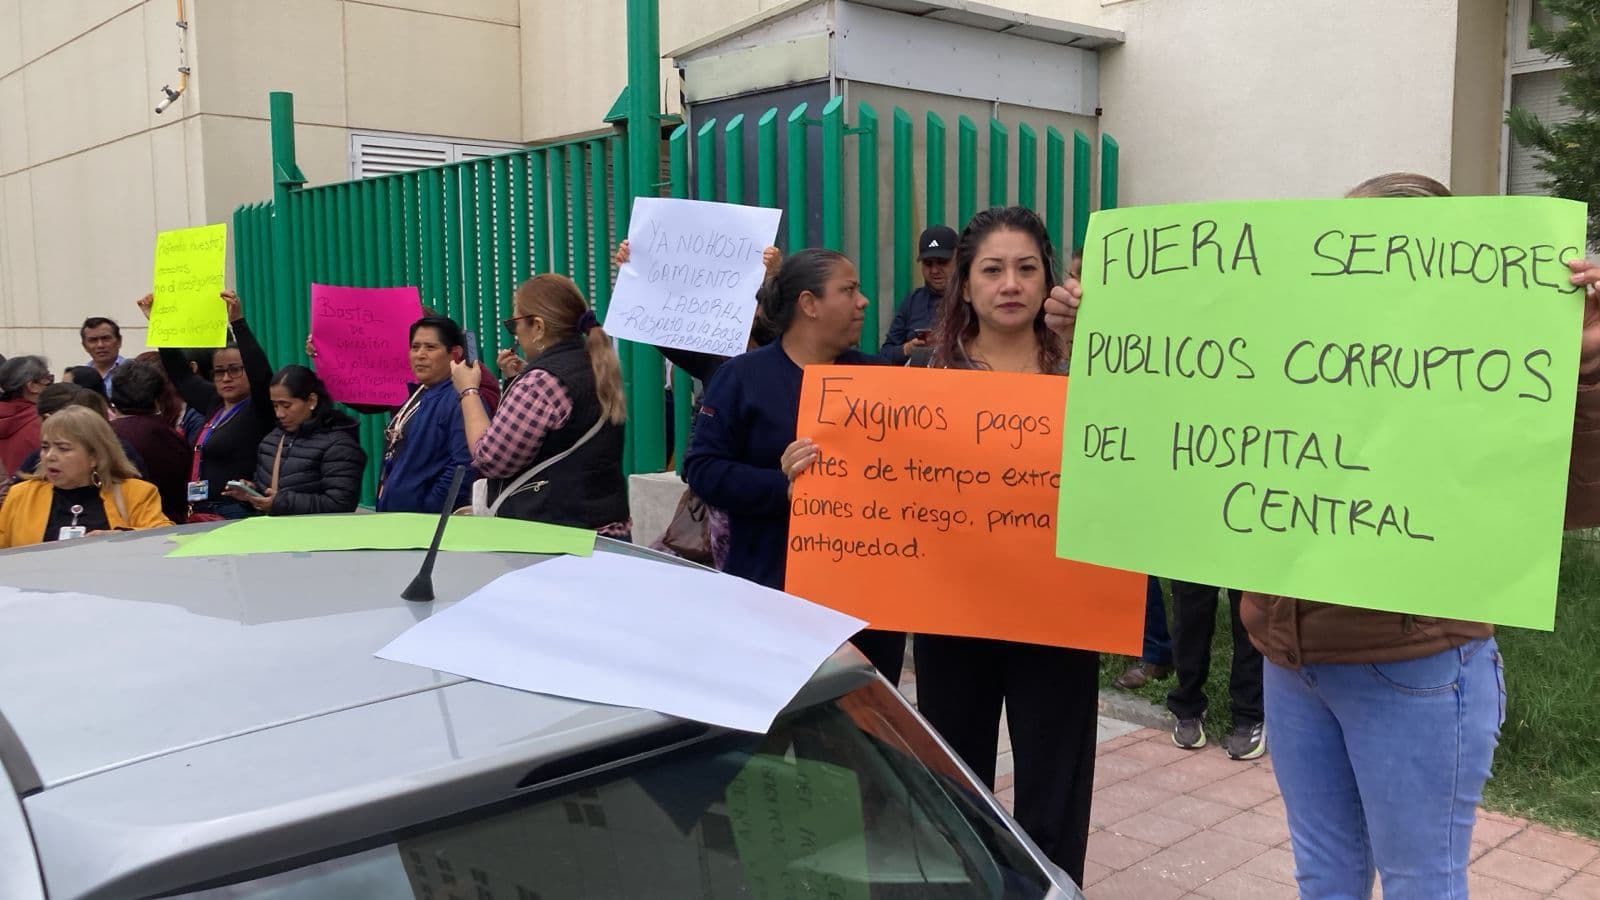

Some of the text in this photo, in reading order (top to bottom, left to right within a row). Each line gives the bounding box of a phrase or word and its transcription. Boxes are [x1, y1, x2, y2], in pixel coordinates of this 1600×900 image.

[650, 219, 668, 251] YA
[648, 262, 741, 289] GAMIENTO
[1102, 219, 1580, 294] FUERA SERVIDORES
[663, 290, 743, 324] LABORAL
[1087, 331, 1553, 402] PUBLICOS CORRUPTOS
[976, 409, 1052, 450] pagos
[1084, 421, 1370, 471] DEL HOSPITAL
[863, 458, 898, 483] de
[904, 459, 991, 493] tiempo
[792, 493, 853, 518] ciones
[862, 500, 891, 520] de
[987, 508, 1051, 533] prima
[1222, 481, 1435, 542] CENTRAL
[790, 533, 926, 563] antiguedad.
